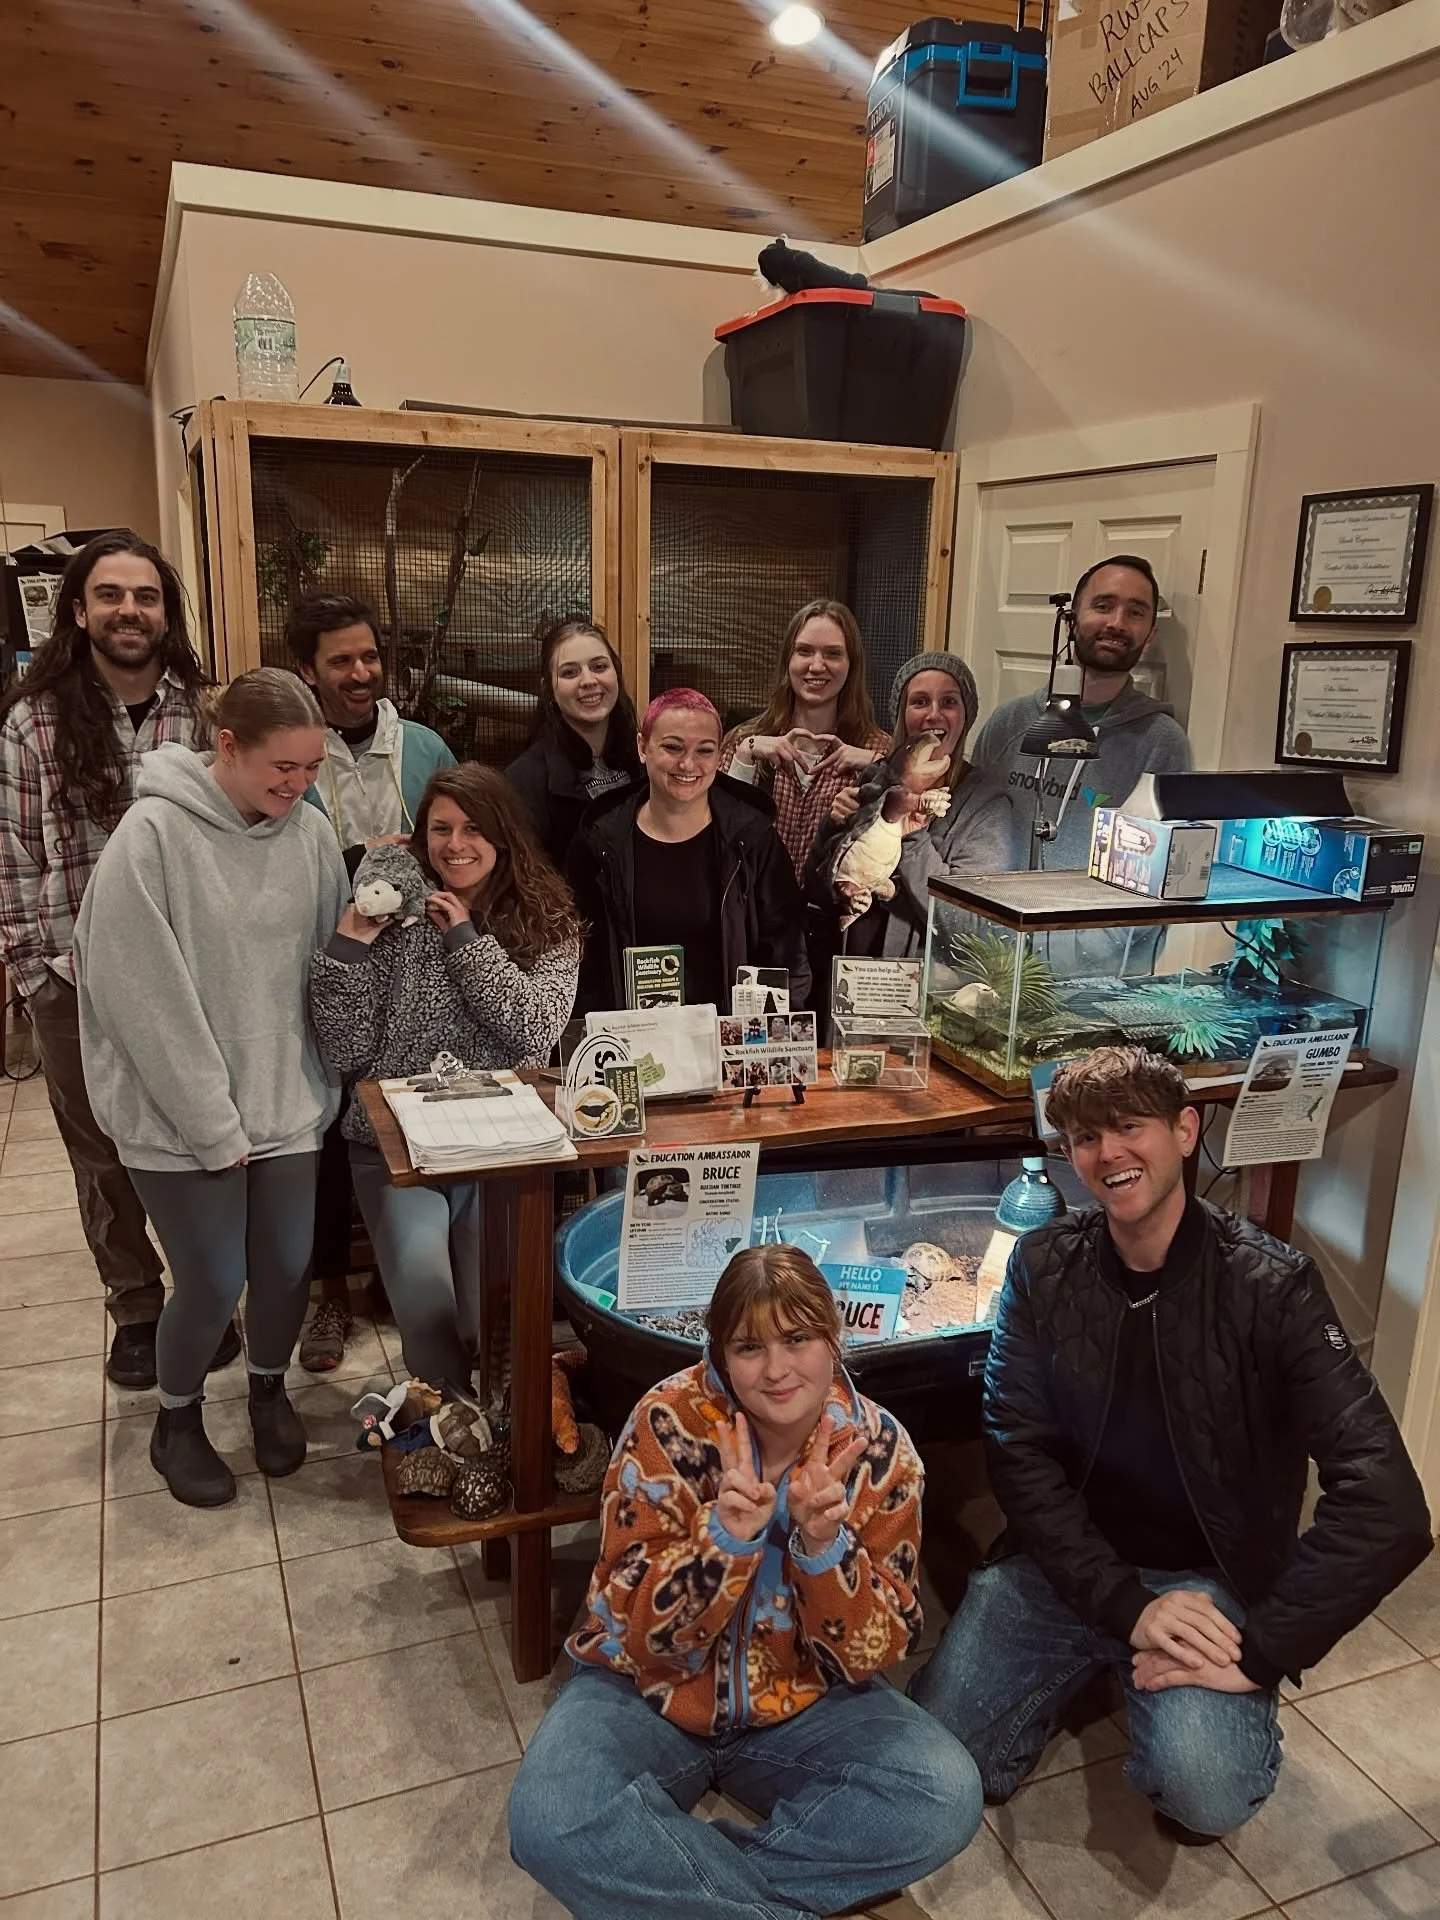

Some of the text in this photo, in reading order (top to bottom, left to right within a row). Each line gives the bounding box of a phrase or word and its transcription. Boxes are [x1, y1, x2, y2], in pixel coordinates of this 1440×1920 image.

[1131, 47, 1184, 118] AUG '24
[636, 956, 660, 965] Rockfish
[635, 969, 662, 977] Sanctuary
[637, 963, 660, 971] Wildlife
[878, 966, 892, 974] help
[1272, 1033, 1350, 1047] EDUCATION AMBASSADOR
[735, 1045, 814, 1056] Rockfish Wildlife Sanctuary
[1305, 1046, 1341, 1059] GUMBO
[650, 1150, 751, 1163] EDUCATION AMBASSADOR
[702, 1166, 742, 1180] BRUCE
[840, 1265, 882, 1281] HELLO
[838, 1281, 850, 1289] MY
[850, 1282, 872, 1290] NAME
